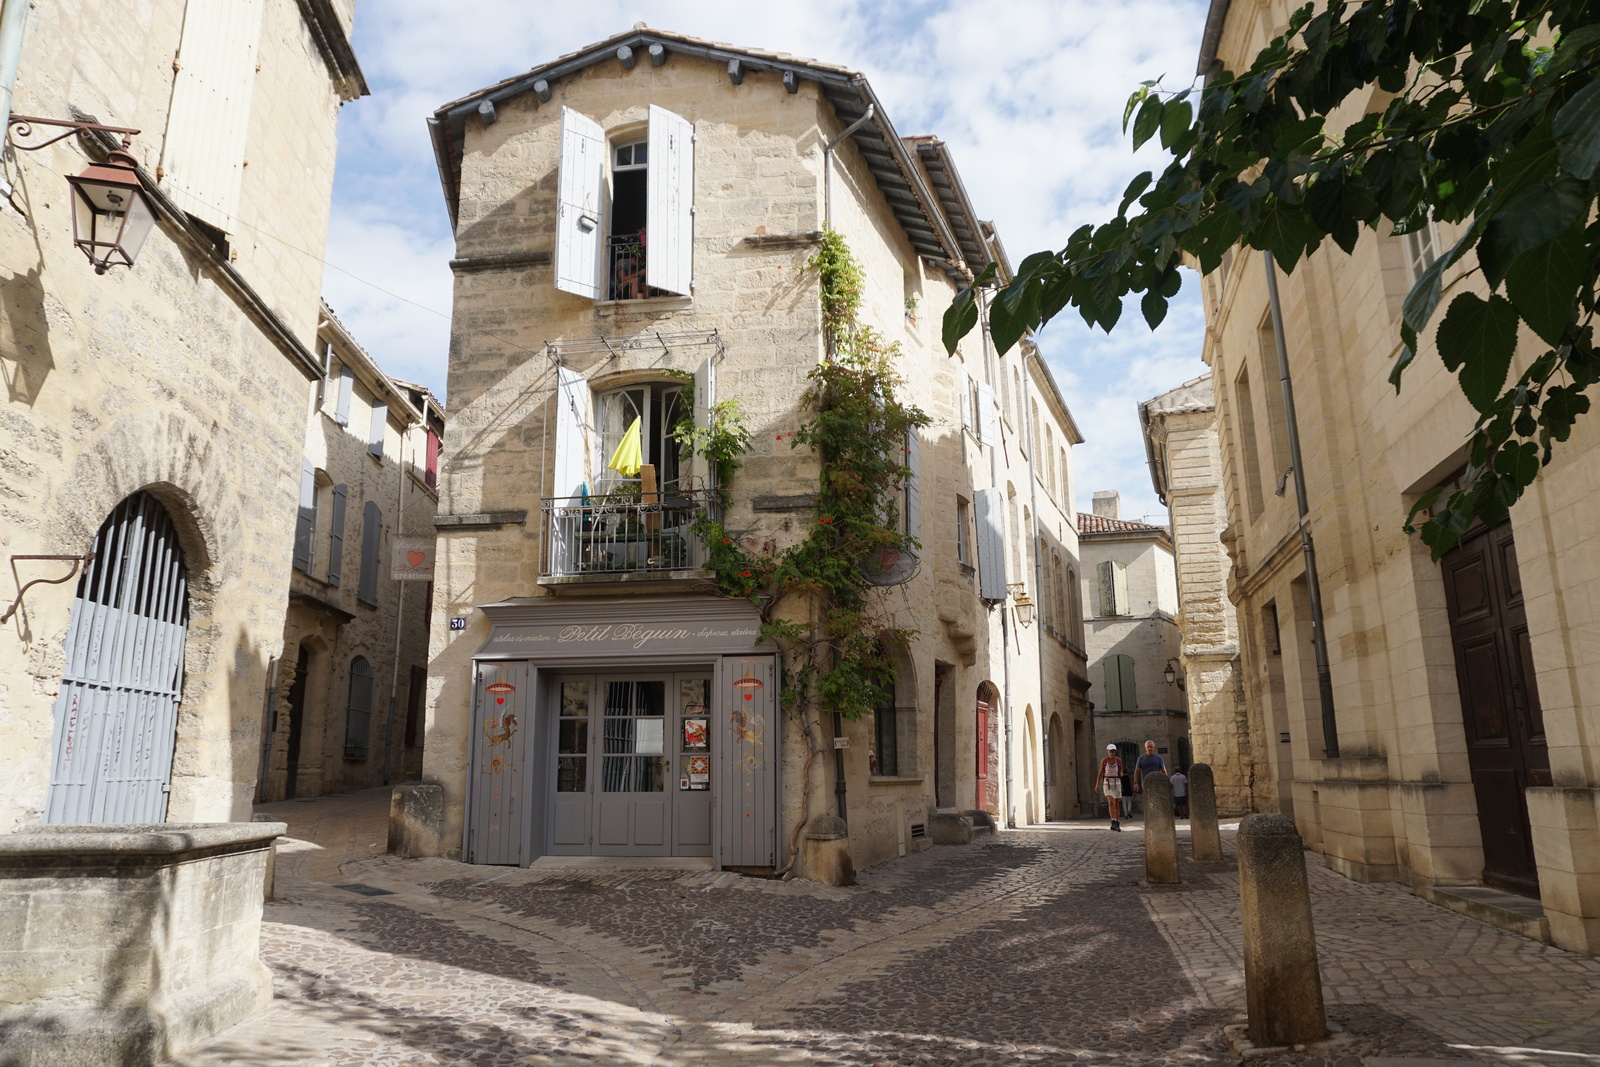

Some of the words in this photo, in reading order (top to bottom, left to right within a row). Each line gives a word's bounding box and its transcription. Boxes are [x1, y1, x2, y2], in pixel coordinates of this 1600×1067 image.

[394, 572, 433, 580] créations
[451, 618, 465, 629] 30
[557, 624, 613, 643] Petit
